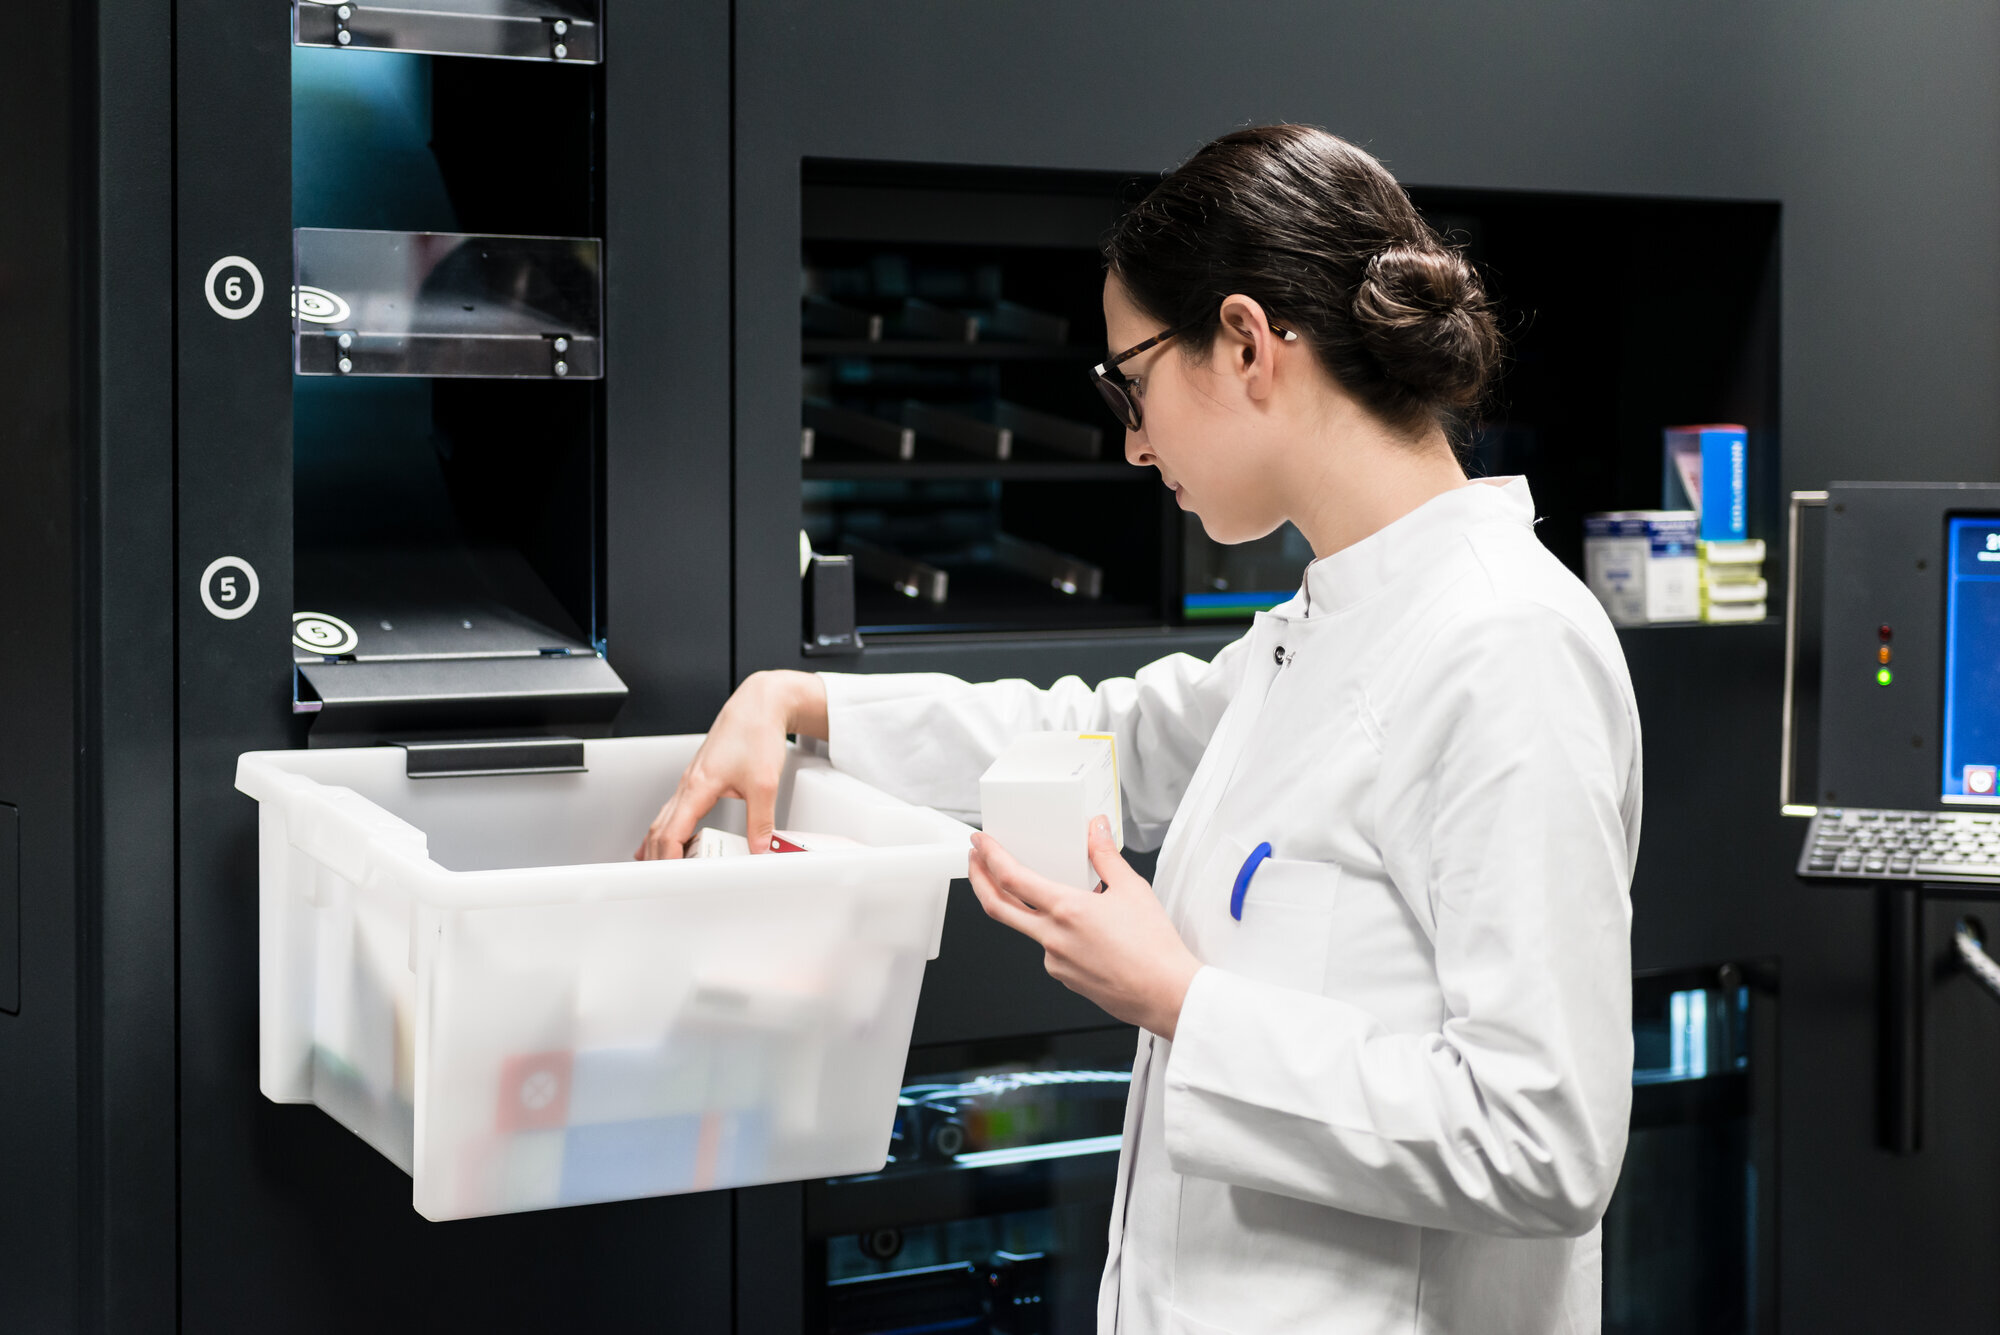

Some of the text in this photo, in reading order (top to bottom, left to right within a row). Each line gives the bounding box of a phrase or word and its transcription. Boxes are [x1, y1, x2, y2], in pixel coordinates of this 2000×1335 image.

[225, 276, 242, 302] 6
[221, 576, 237, 602] 5
[310, 626, 328, 639] 5
